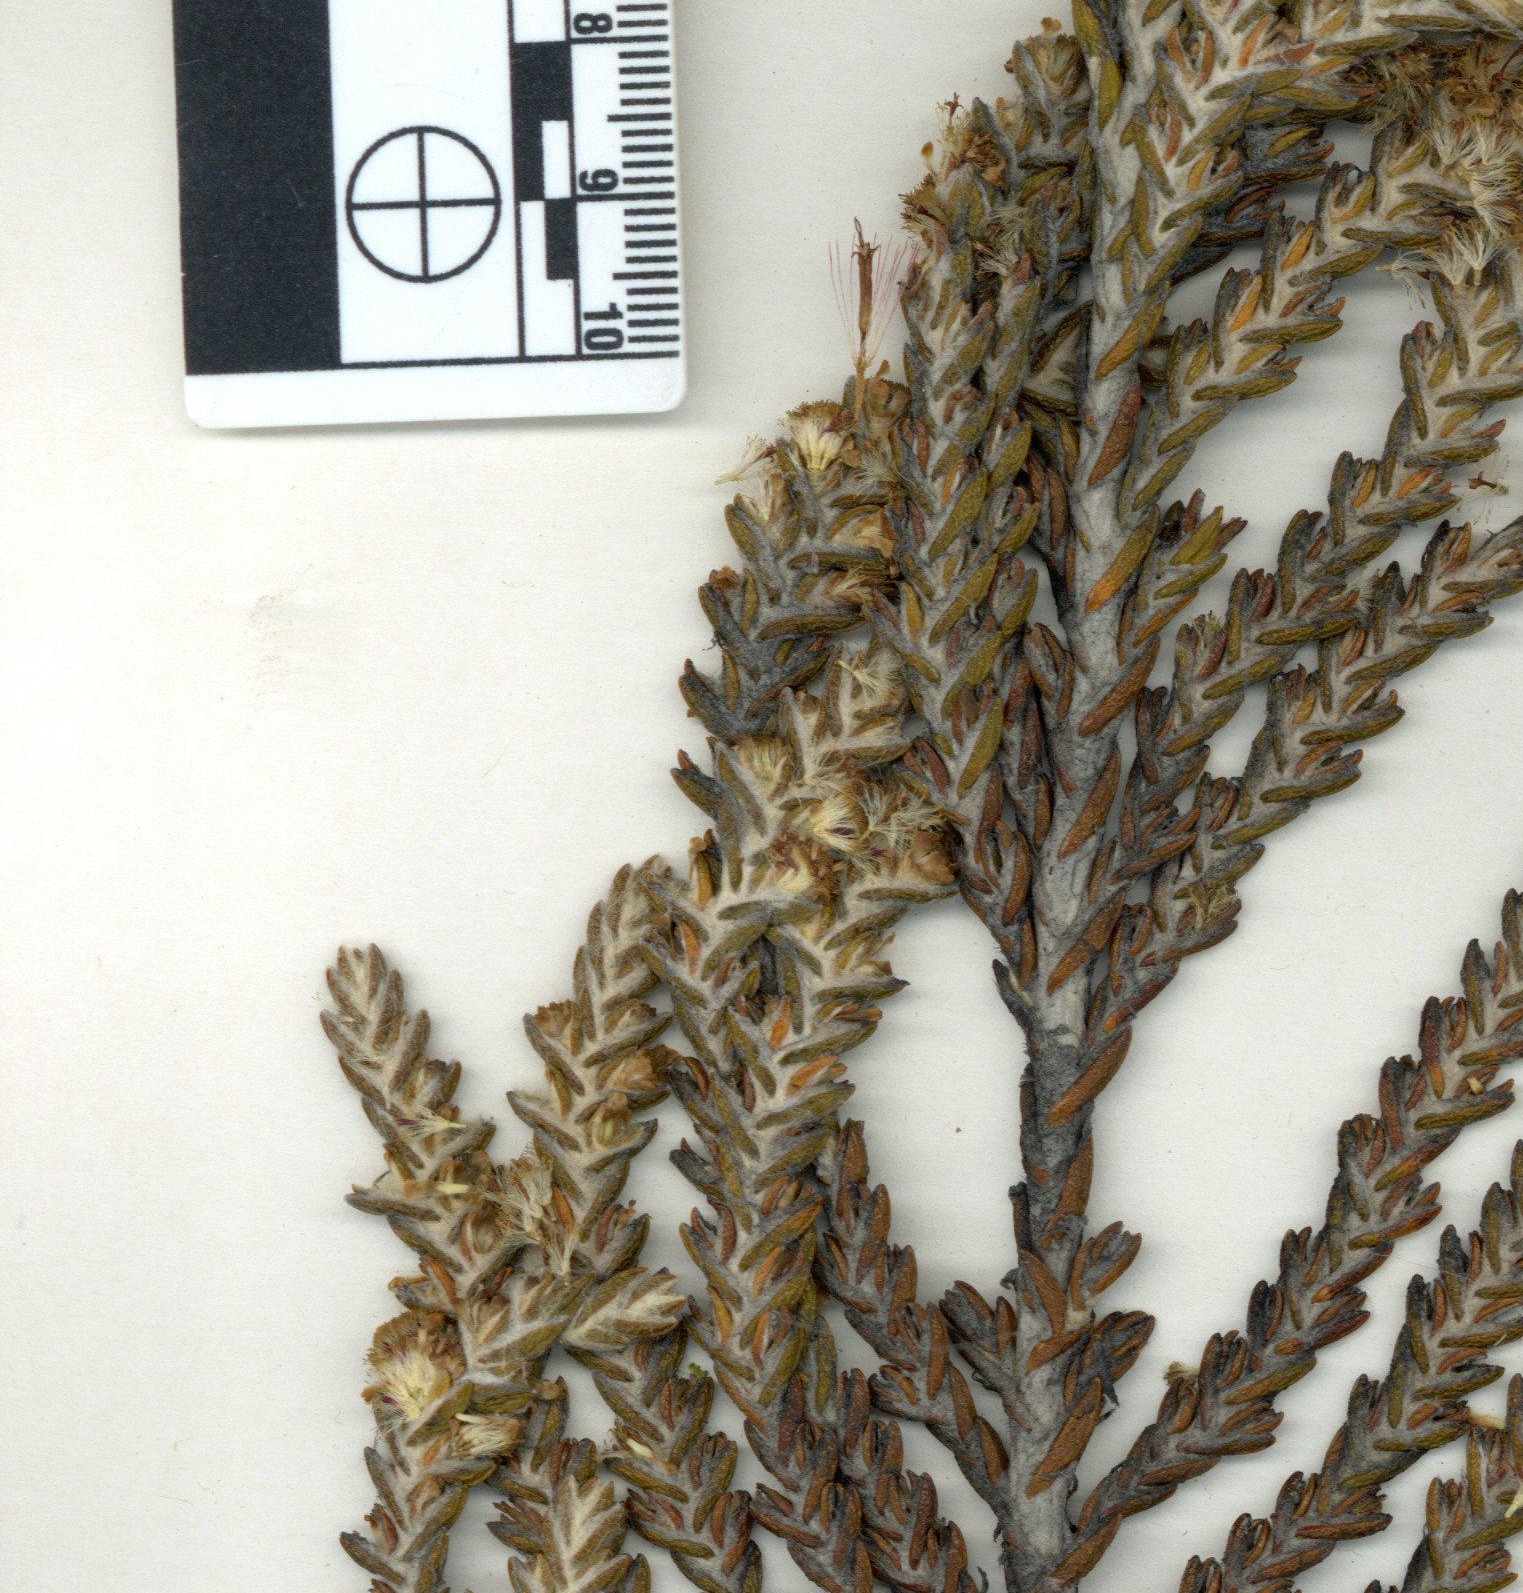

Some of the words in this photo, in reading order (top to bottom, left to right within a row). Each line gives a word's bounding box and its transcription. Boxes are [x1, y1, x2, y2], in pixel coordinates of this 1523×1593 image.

[574, 12, 613, 36] 8
[579, 168, 619, 193] 9
[583, 302, 624, 351] 10
